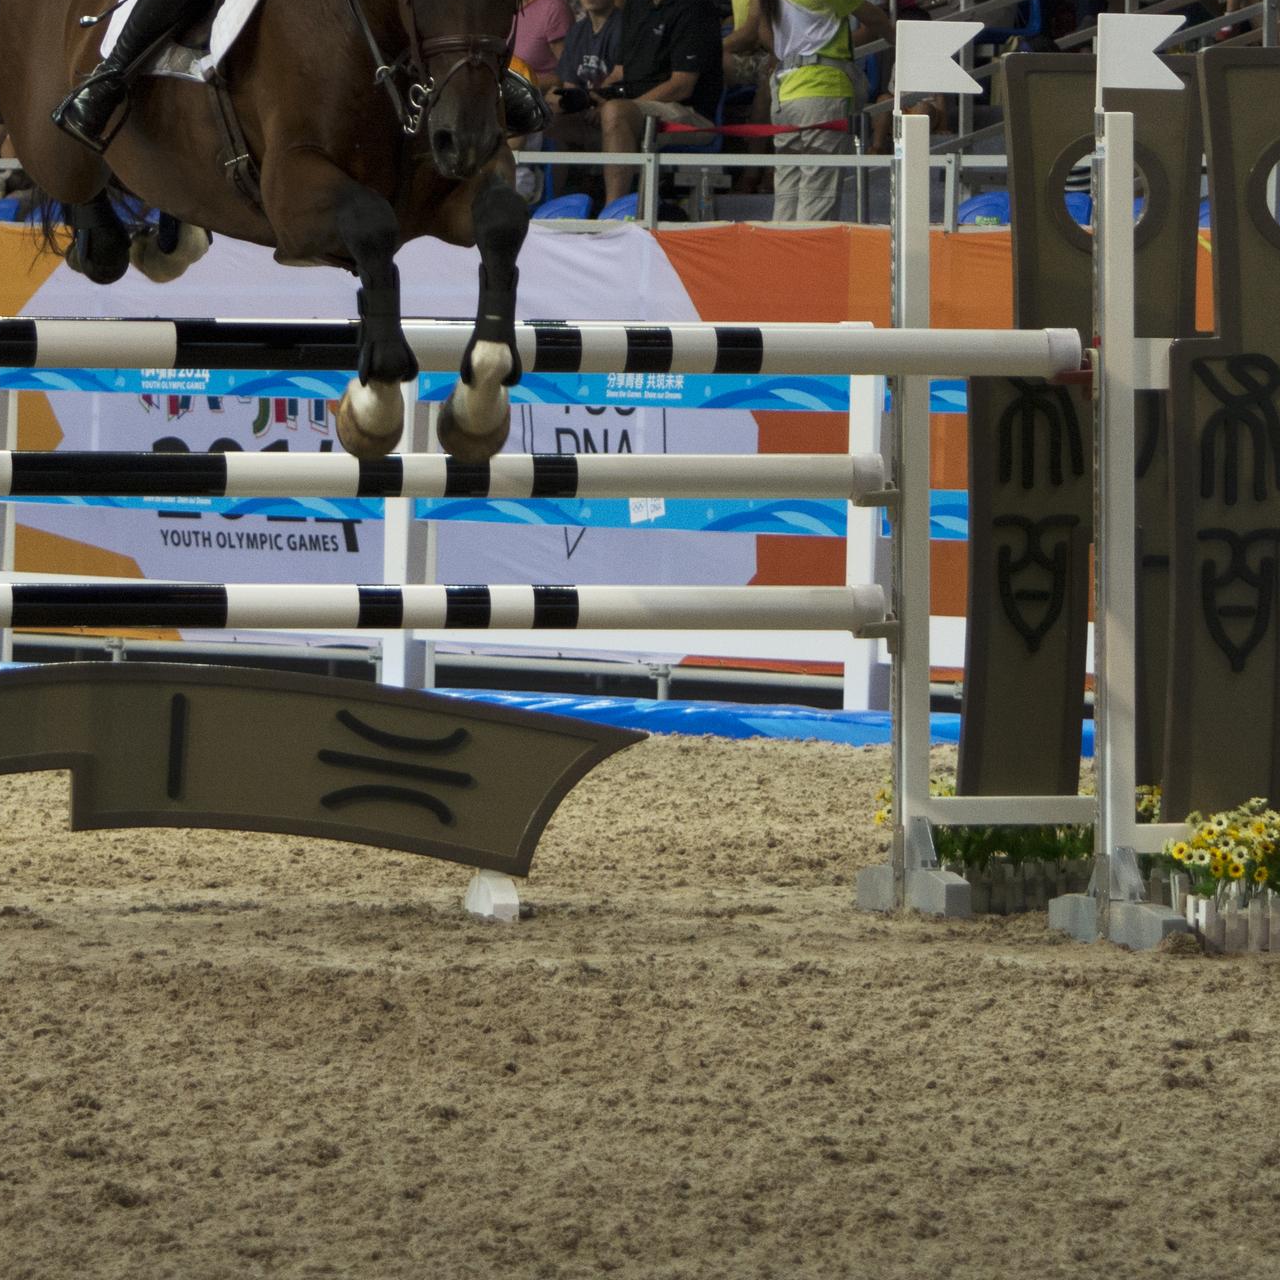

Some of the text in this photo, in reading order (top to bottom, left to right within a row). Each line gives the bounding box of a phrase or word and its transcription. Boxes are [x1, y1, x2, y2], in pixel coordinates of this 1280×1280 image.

[160, 528, 213, 549] YOUTH
[216, 531, 284, 551] OLYMPIC
[286, 533, 340, 552] GAMES
